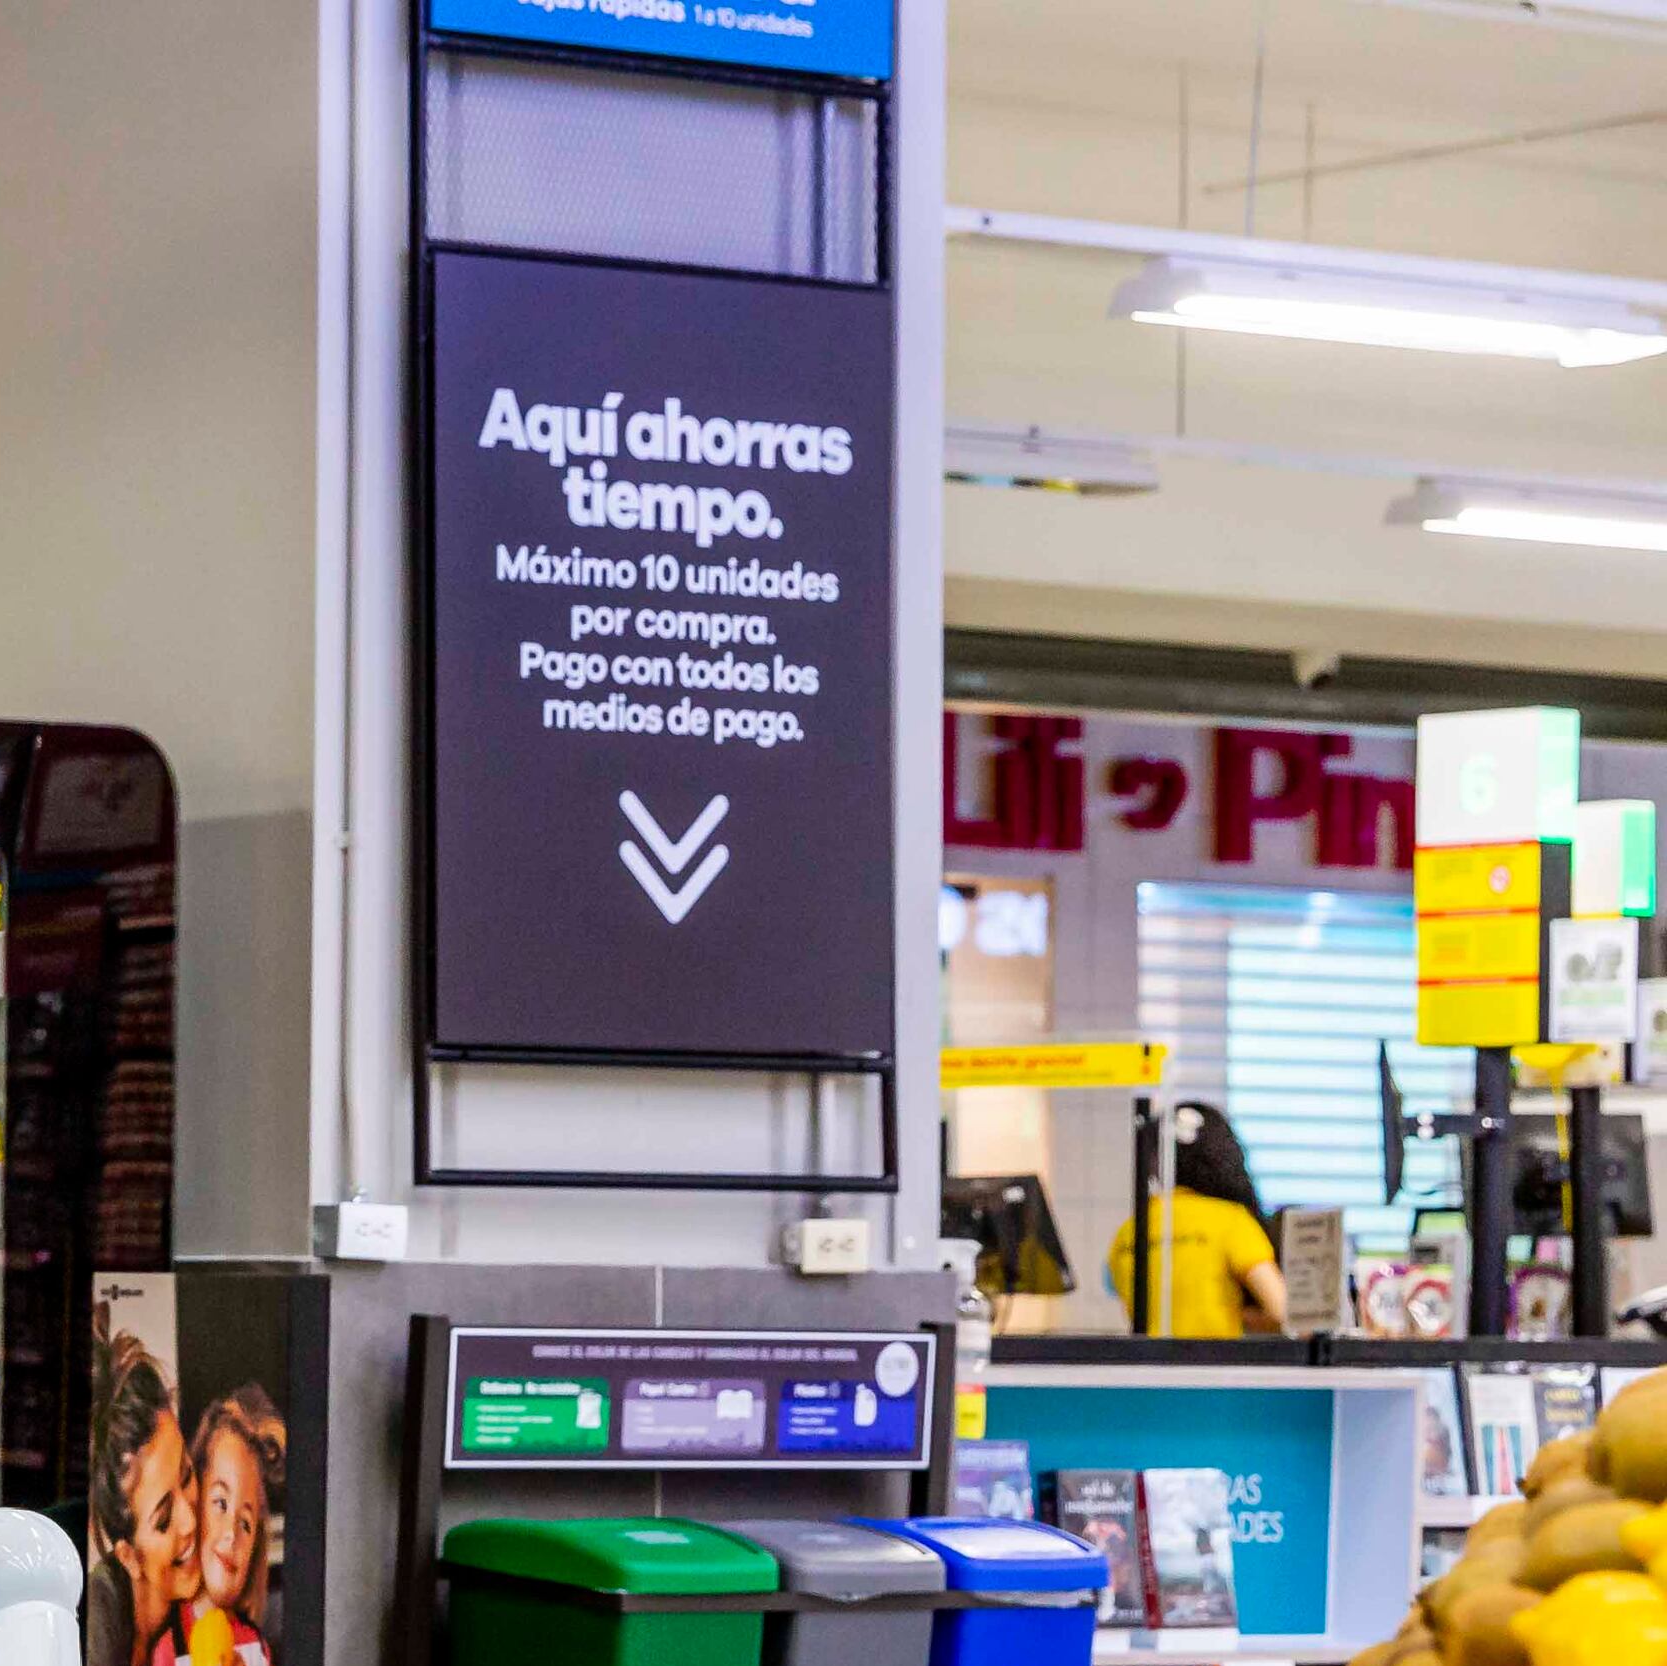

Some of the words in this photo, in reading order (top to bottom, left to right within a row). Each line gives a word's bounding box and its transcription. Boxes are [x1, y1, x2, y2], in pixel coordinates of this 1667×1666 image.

[479, 388, 624, 466] Aquí
[626, 398, 853, 475] ahorras
[563, 460, 784, 547] tiempo.
[496, 545, 637, 589] Máximo
[641, 554, 680, 591] 10
[686, 558, 840, 602] unidades
[571, 605, 631, 641] por
[635, 609, 777, 649] compra.
[520, 641, 608, 690] Pago
[612, 655, 673, 686] con
[677, 651, 770, 692] todos
[773, 655, 819, 695] los
[544, 694, 663, 733] medios
[667, 696, 709, 735] de
[714, 711, 804, 748] pago.
[1217, 727, 1415, 871] Pin
[1459, 753, 1499, 816] 6
